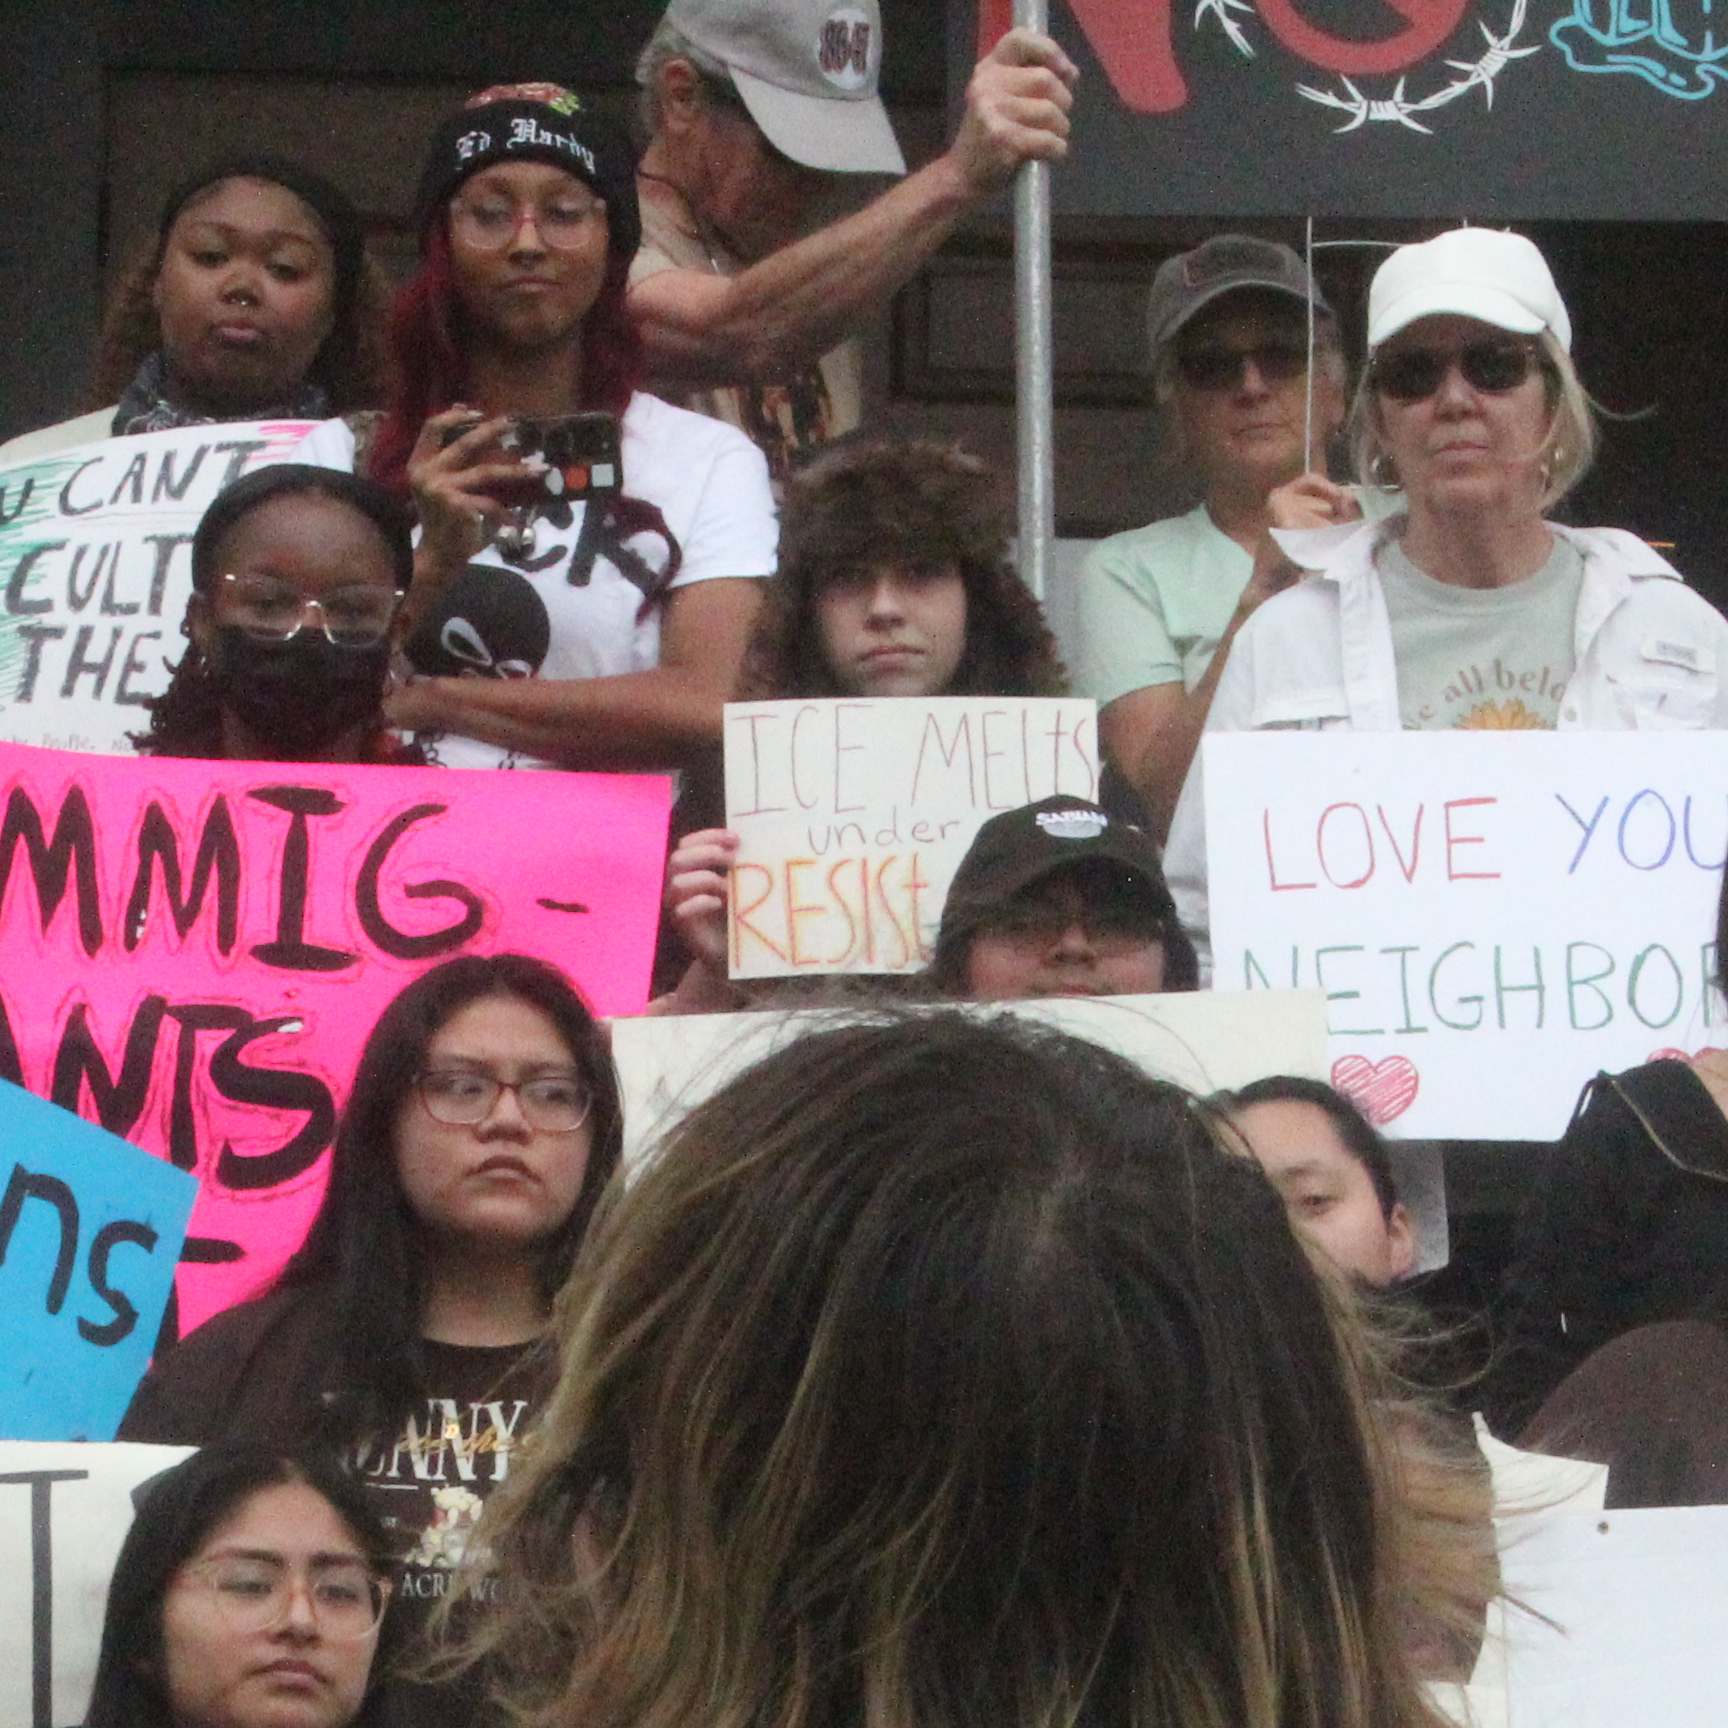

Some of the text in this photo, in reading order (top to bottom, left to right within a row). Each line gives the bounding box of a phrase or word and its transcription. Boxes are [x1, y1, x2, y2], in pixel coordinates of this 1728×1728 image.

[456, 117, 596, 175] Ed Hardy
[730, 703, 874, 818] ICE
[807, 805, 964, 857] under
[1263, 795, 1503, 892] LOVE
